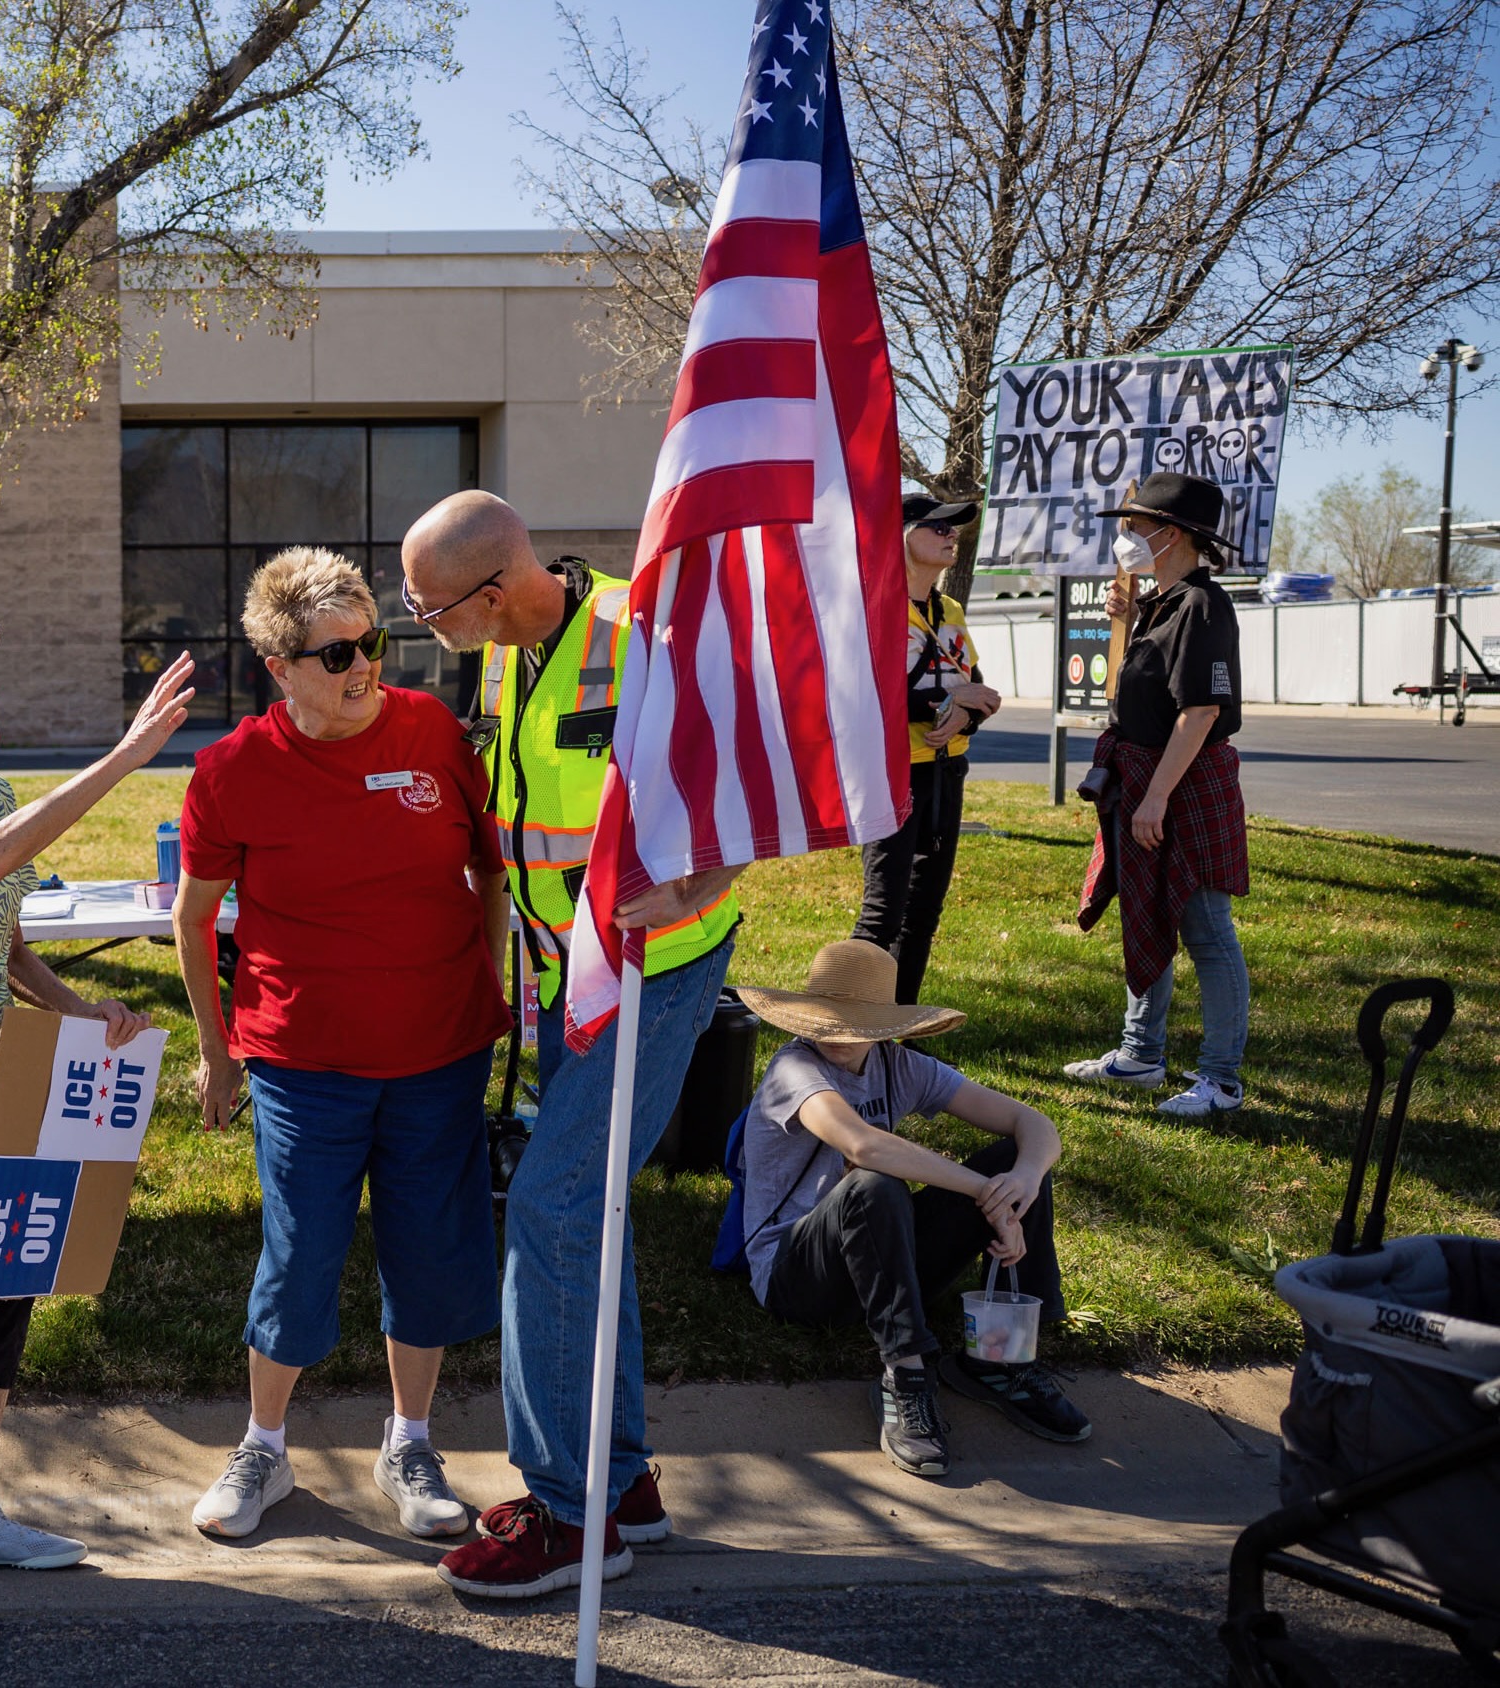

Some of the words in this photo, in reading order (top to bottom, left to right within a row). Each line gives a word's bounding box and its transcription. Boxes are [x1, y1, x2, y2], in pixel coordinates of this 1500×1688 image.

[1003, 359, 1135, 428] YOUR
[1136, 350, 1293, 424] TAXES
[989, 431, 1065, 496] PAY
[1065, 428, 1128, 490] TO
[976, 496, 1075, 566] IZE
[61, 1060, 97, 1120] ICE
[110, 1059, 146, 1130] OUT
[20, 1192, 61, 1264] OUT
[1376, 1306, 1426, 1332] TOUR
